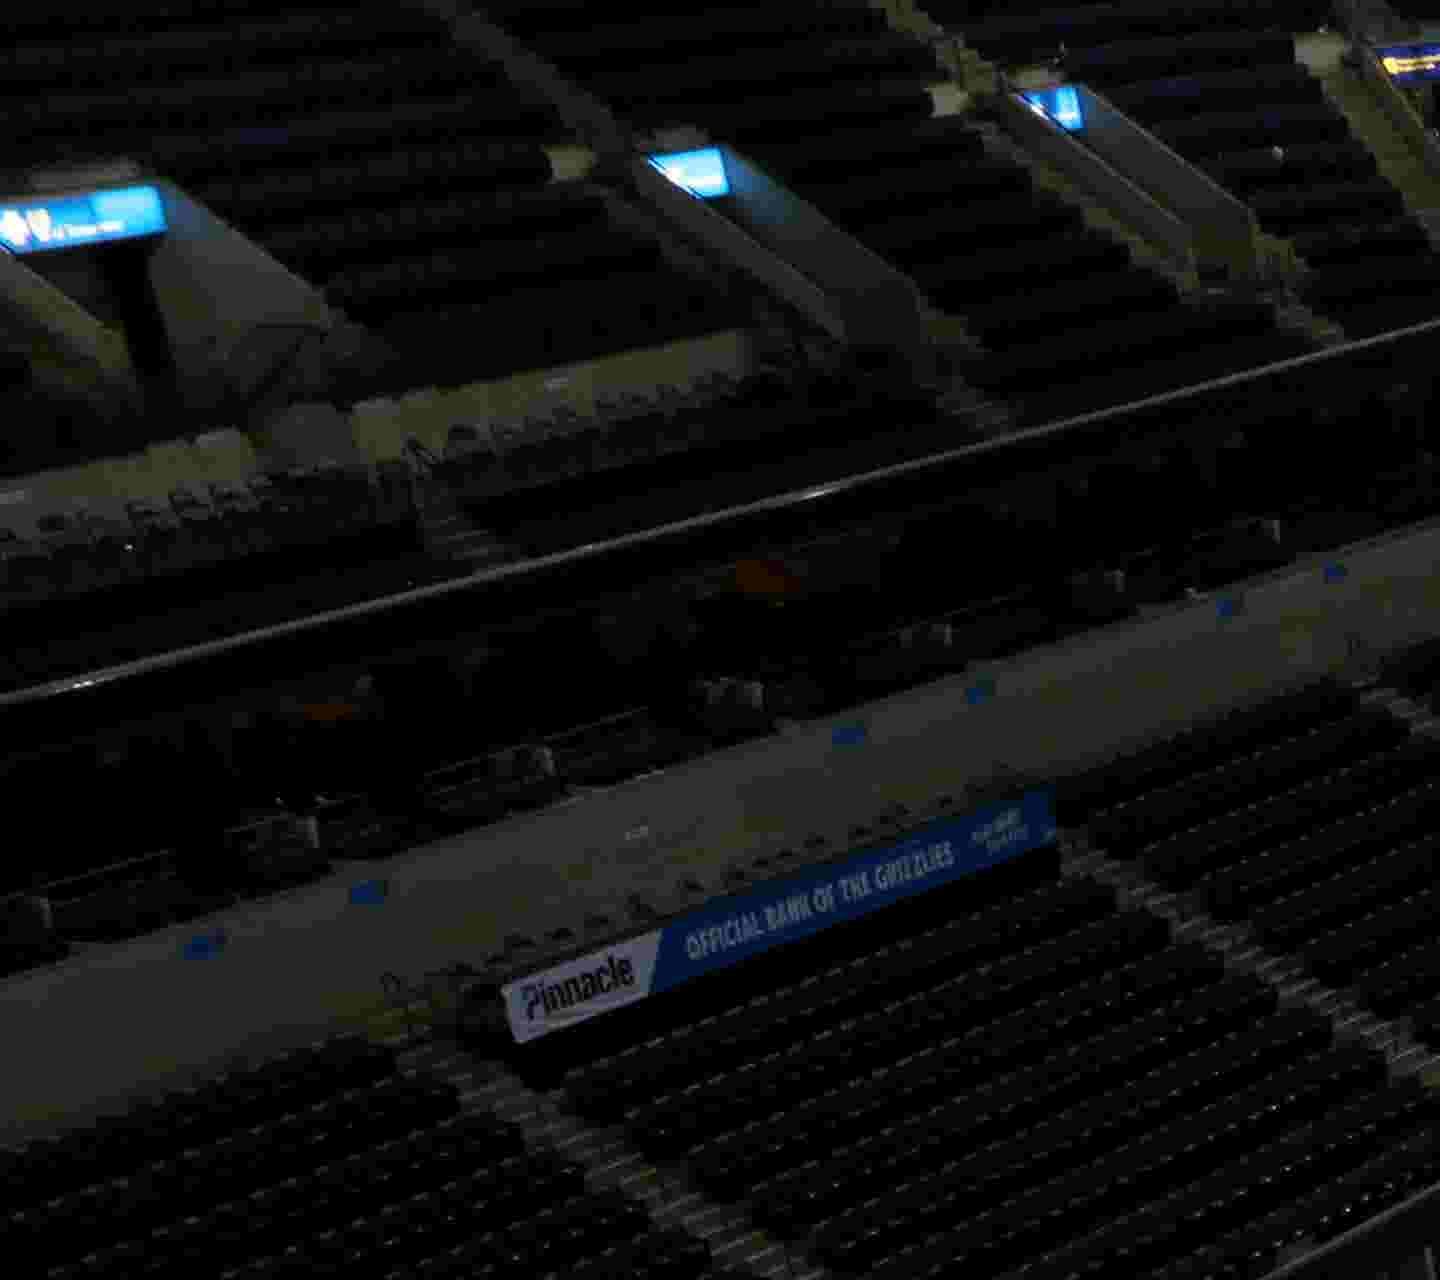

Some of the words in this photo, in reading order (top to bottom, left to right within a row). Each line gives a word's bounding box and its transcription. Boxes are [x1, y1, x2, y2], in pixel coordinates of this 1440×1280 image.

[521, 952, 634, 1021] Pinnacle
[685, 911, 766, 961] OFFICIAL
[765, 889, 816, 935] BANK
[812, 880, 837, 914] OF
[839, 870, 874, 906] THE
[873, 839, 956, 895] GRIZZLIES
